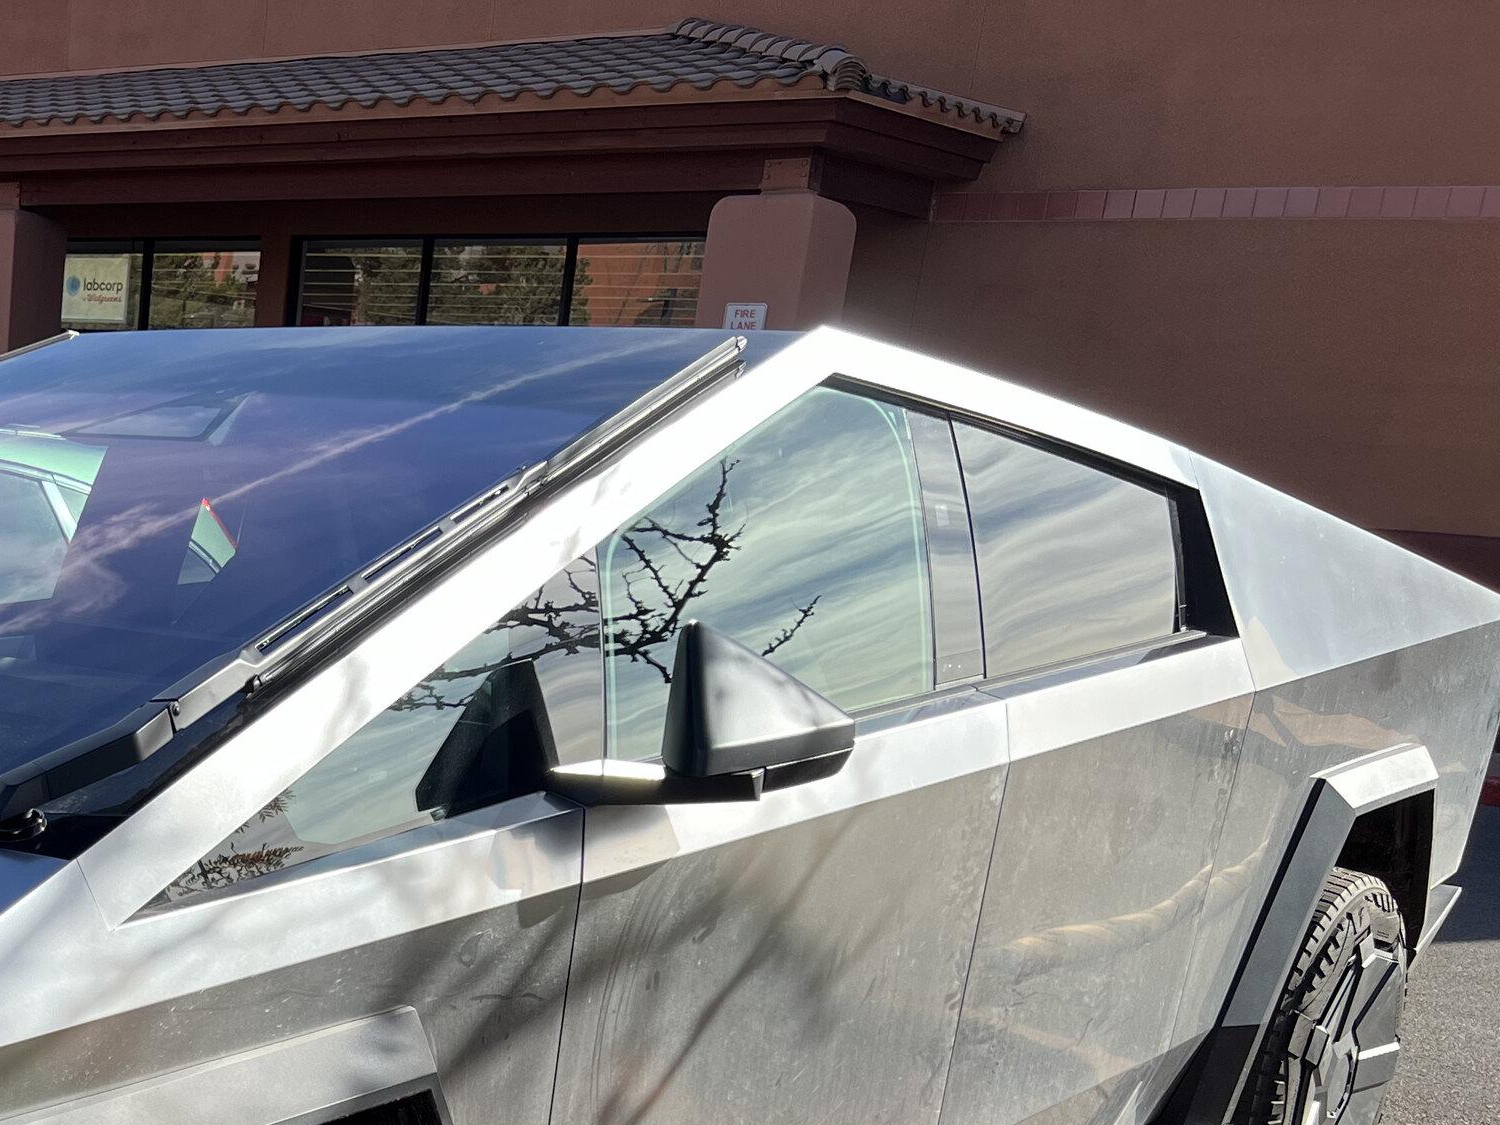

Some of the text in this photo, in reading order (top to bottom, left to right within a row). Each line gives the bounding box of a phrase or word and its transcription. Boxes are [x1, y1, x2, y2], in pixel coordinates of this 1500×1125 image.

[83, 277, 124, 294] labcorp
[734, 309, 756, 318] FIRE
[731, 322, 756, 330] LANE
